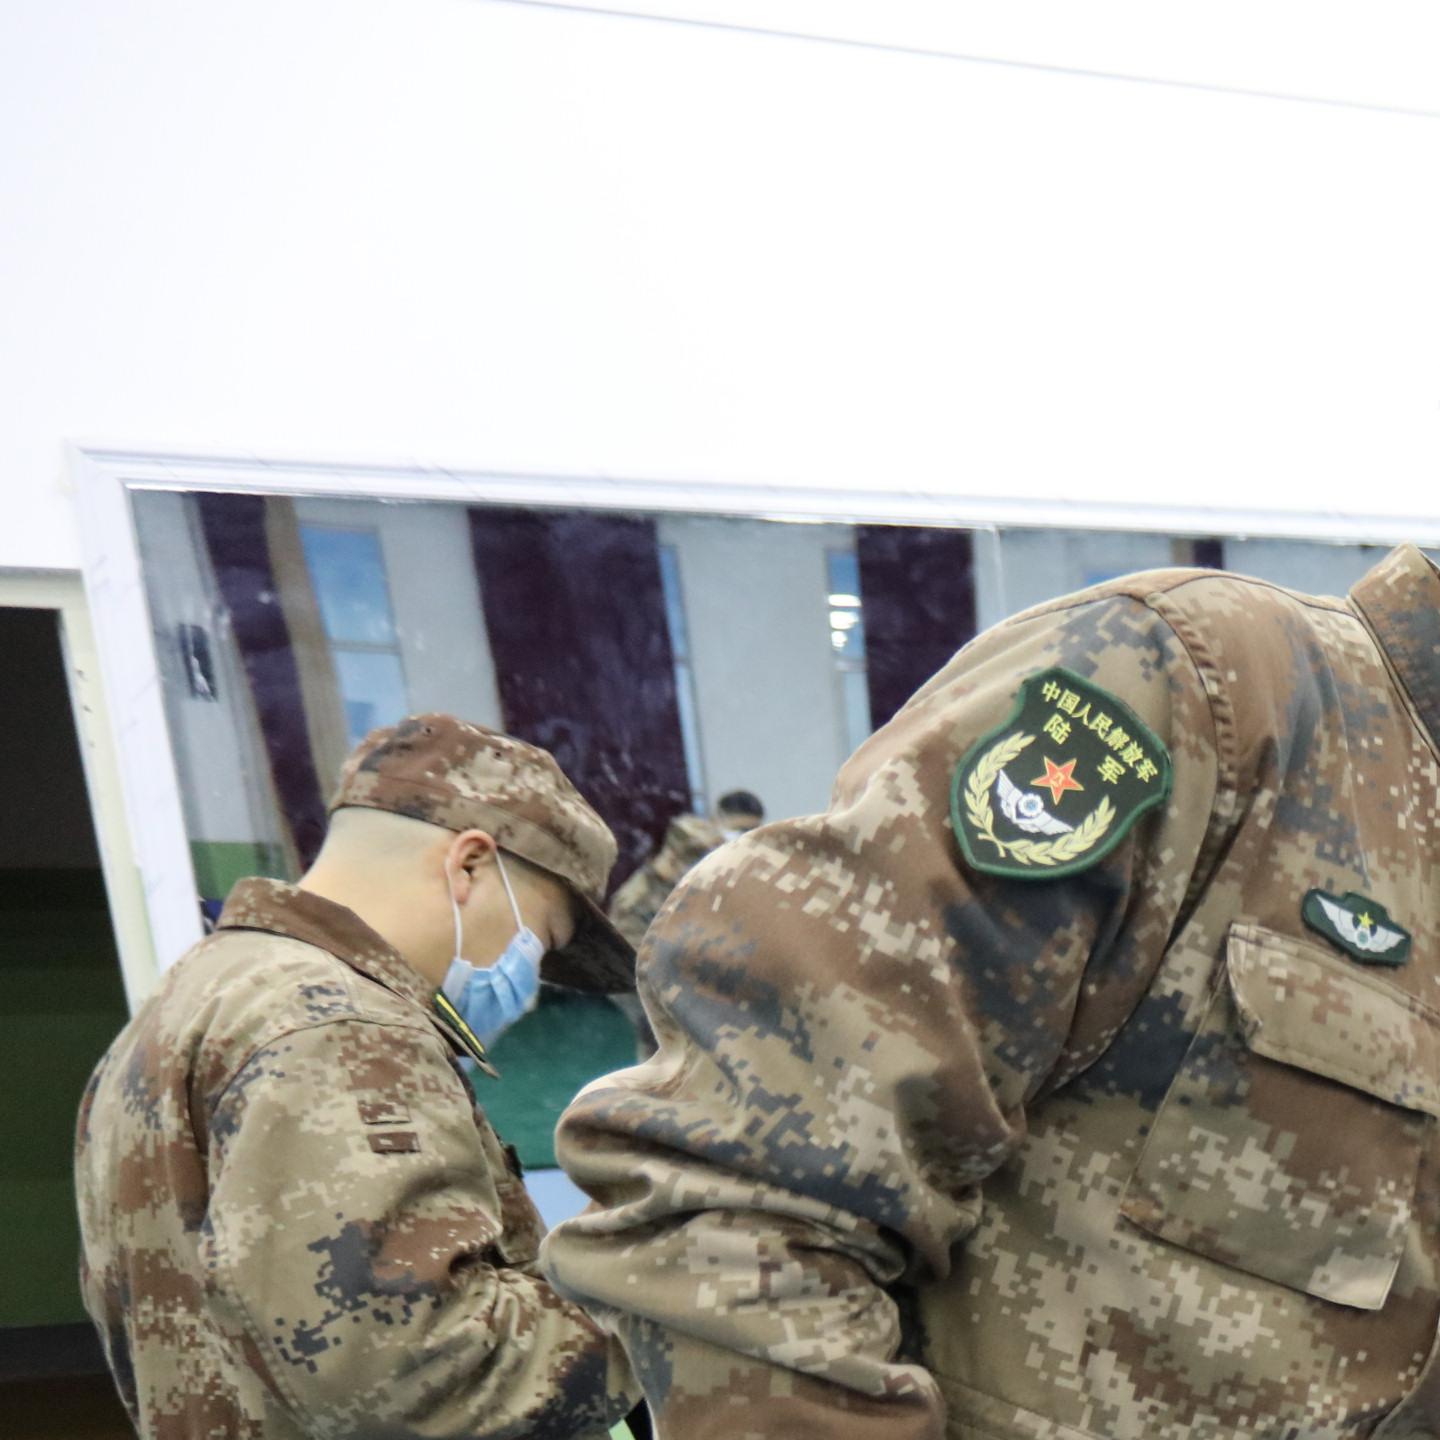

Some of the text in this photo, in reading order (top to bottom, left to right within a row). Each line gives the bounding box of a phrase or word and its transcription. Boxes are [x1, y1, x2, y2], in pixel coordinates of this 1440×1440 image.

[1042, 681, 1158, 783] 中国人民解放军
